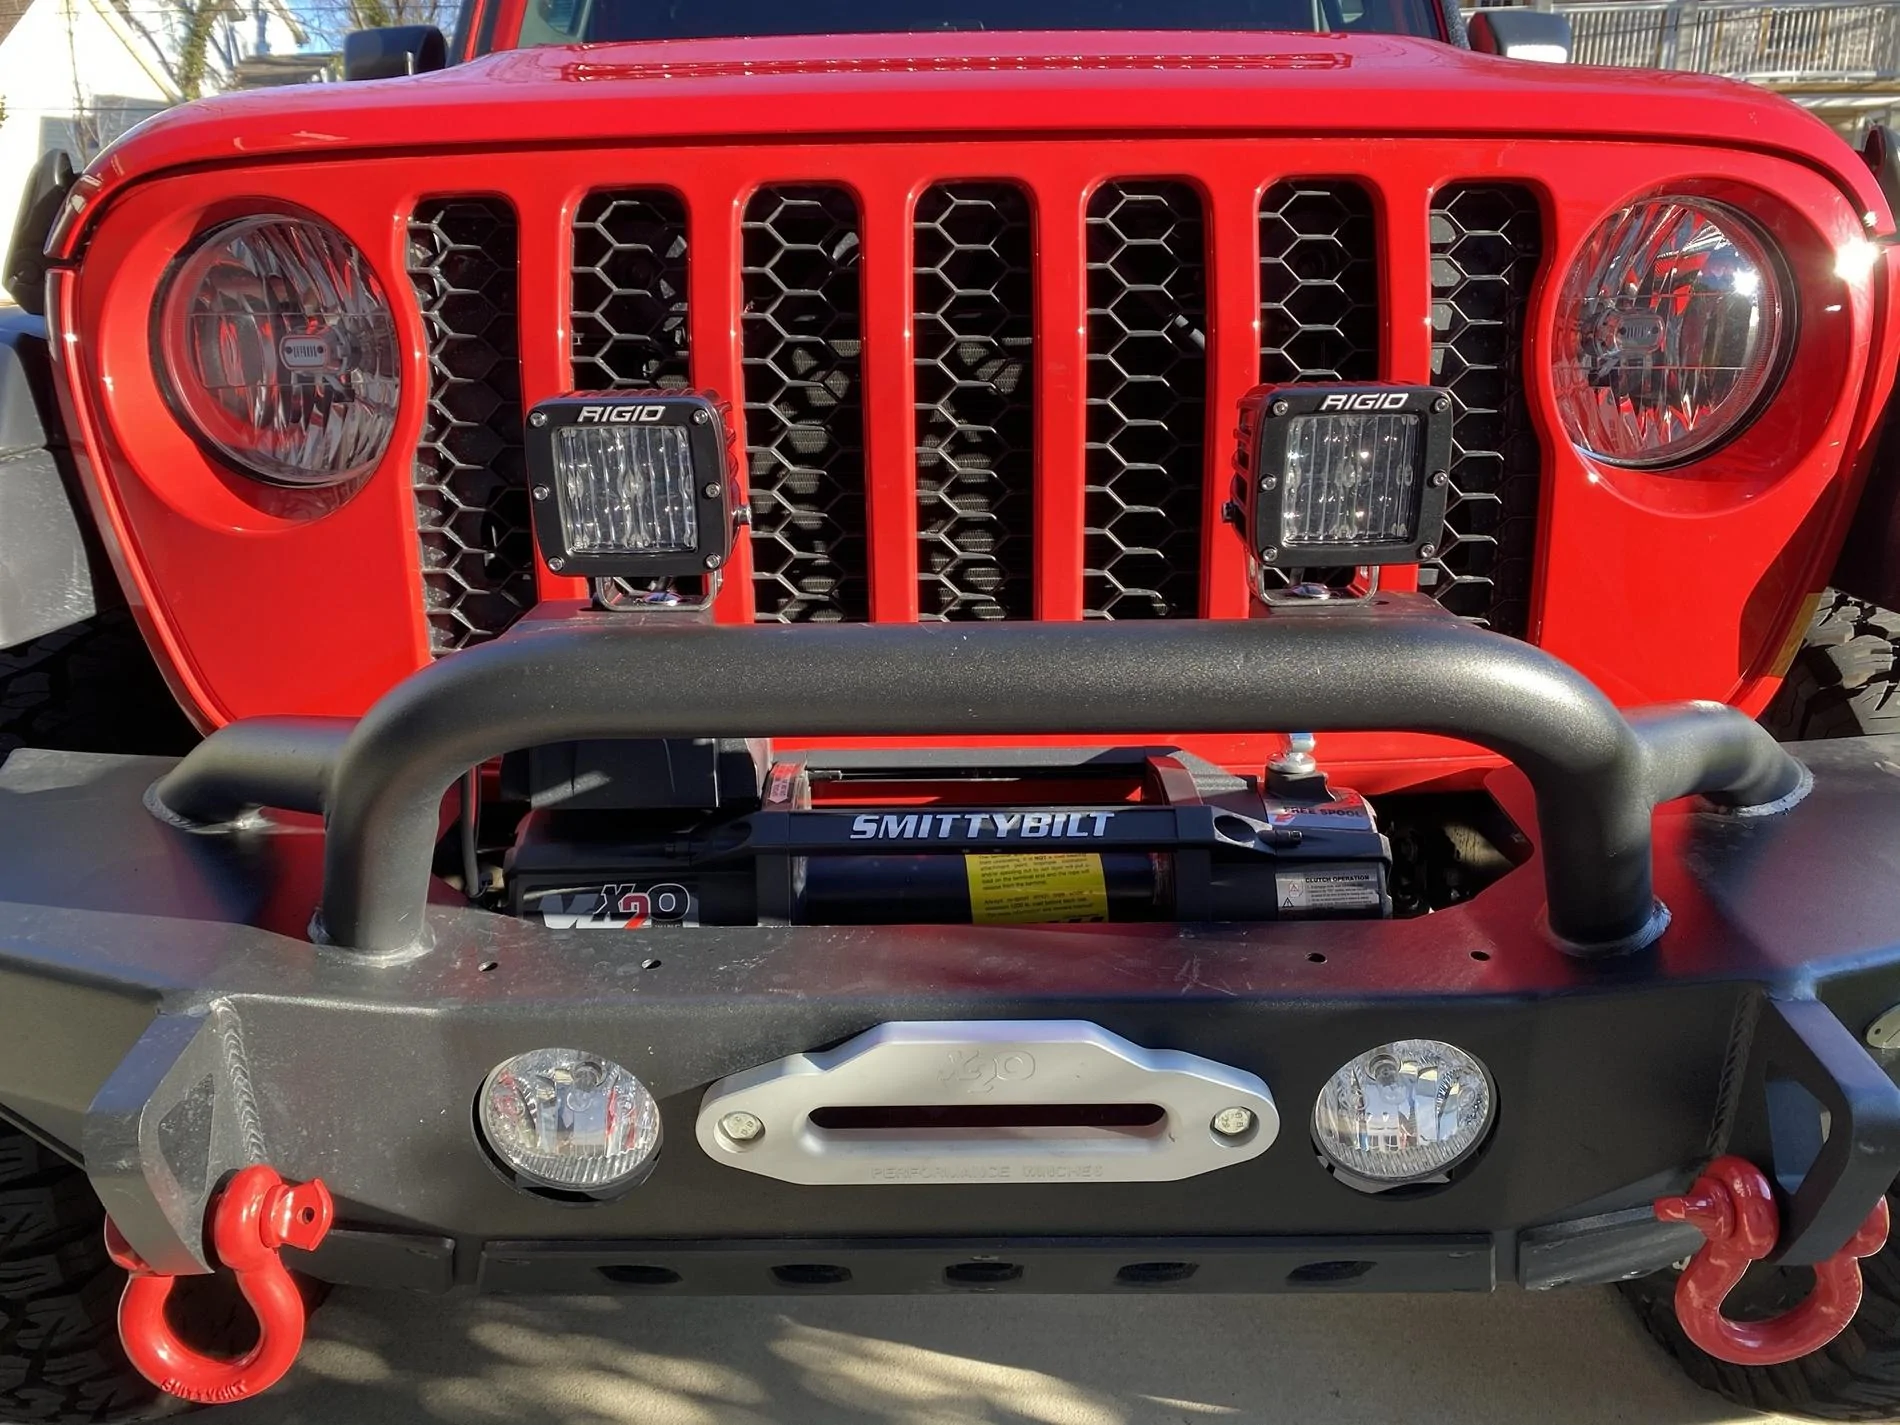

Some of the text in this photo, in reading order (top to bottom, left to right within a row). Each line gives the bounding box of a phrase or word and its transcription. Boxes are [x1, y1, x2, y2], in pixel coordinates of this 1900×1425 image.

[1319, 392, 1409, 411] RIGID
[577, 405, 666, 422] RIGID
[1320, 808, 1363, 817] SPOOL
[850, 812, 1115, 839] SMITTYBILT
[1332, 874, 1370, 882] OPERATION
